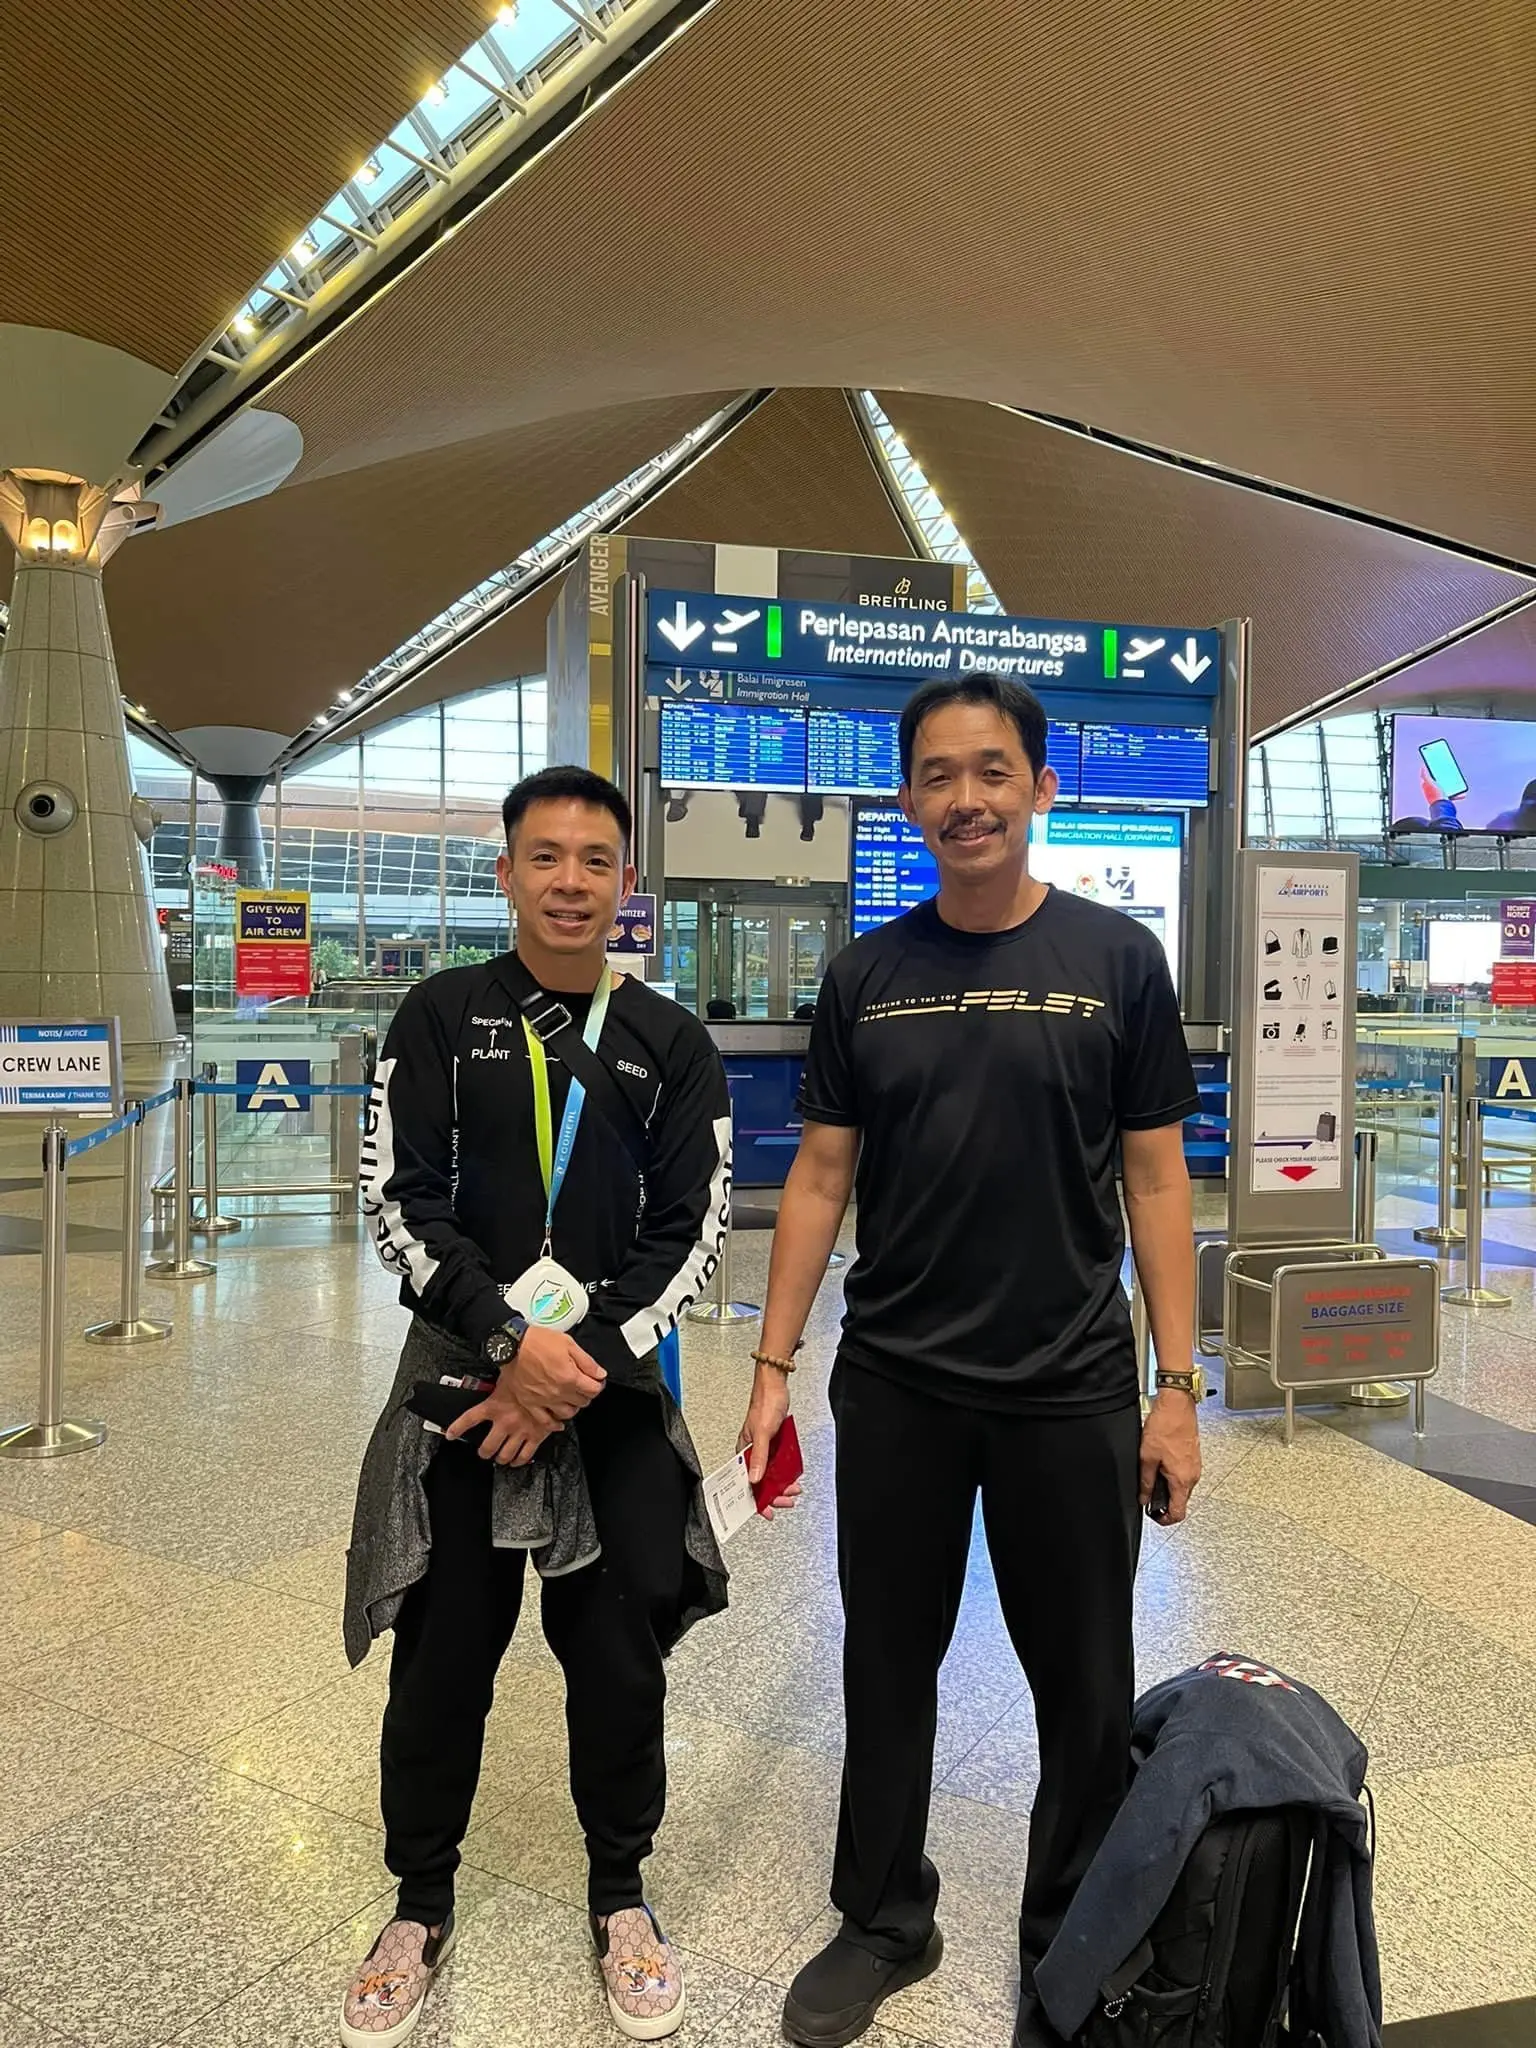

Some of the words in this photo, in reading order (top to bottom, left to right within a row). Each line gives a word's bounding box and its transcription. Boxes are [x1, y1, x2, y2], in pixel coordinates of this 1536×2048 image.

[589, 535, 609, 616] AVENGER
[858, 594, 948, 611] BREITLING
[799, 609, 926, 644] Perlepasan
[931, 618, 1089, 657] Antarabangsa
[826, 639, 952, 669] International
[959, 649, 1065, 677] Departures
[736, 673, 759, 685] Balai
[763, 675, 807, 690] Imigresen
[736, 687, 787, 701] Immigration
[790, 690, 810, 702] Hall
[1049, 831, 1101, 841] IMMIGRATION
[1103, 833, 1123, 841] HALL
[1292, 888, 1329, 897] AIRPORTS
[246, 905, 273, 914] GIVE
[275, 905, 301, 914] WAY
[265, 916, 282, 925] TO
[245, 928, 264, 936] AIR
[267, 928, 302, 937] CREW
[940, 994, 957, 1002] TOP
[63, 1029, 88, 1037] NOTICE
[471, 1048, 511, 1061] PLANT
[2, 1056, 51, 1073] CREW
[57, 1056, 101, 1072] LANE
[616, 1059, 649, 1080] SEED
[247, 1063, 300, 1109] A
[1495, 1059, 1532, 1097] A
[1311, 1305, 1374, 1319] BAGGAGE
[1377, 1302, 1405, 1314] SIZE
